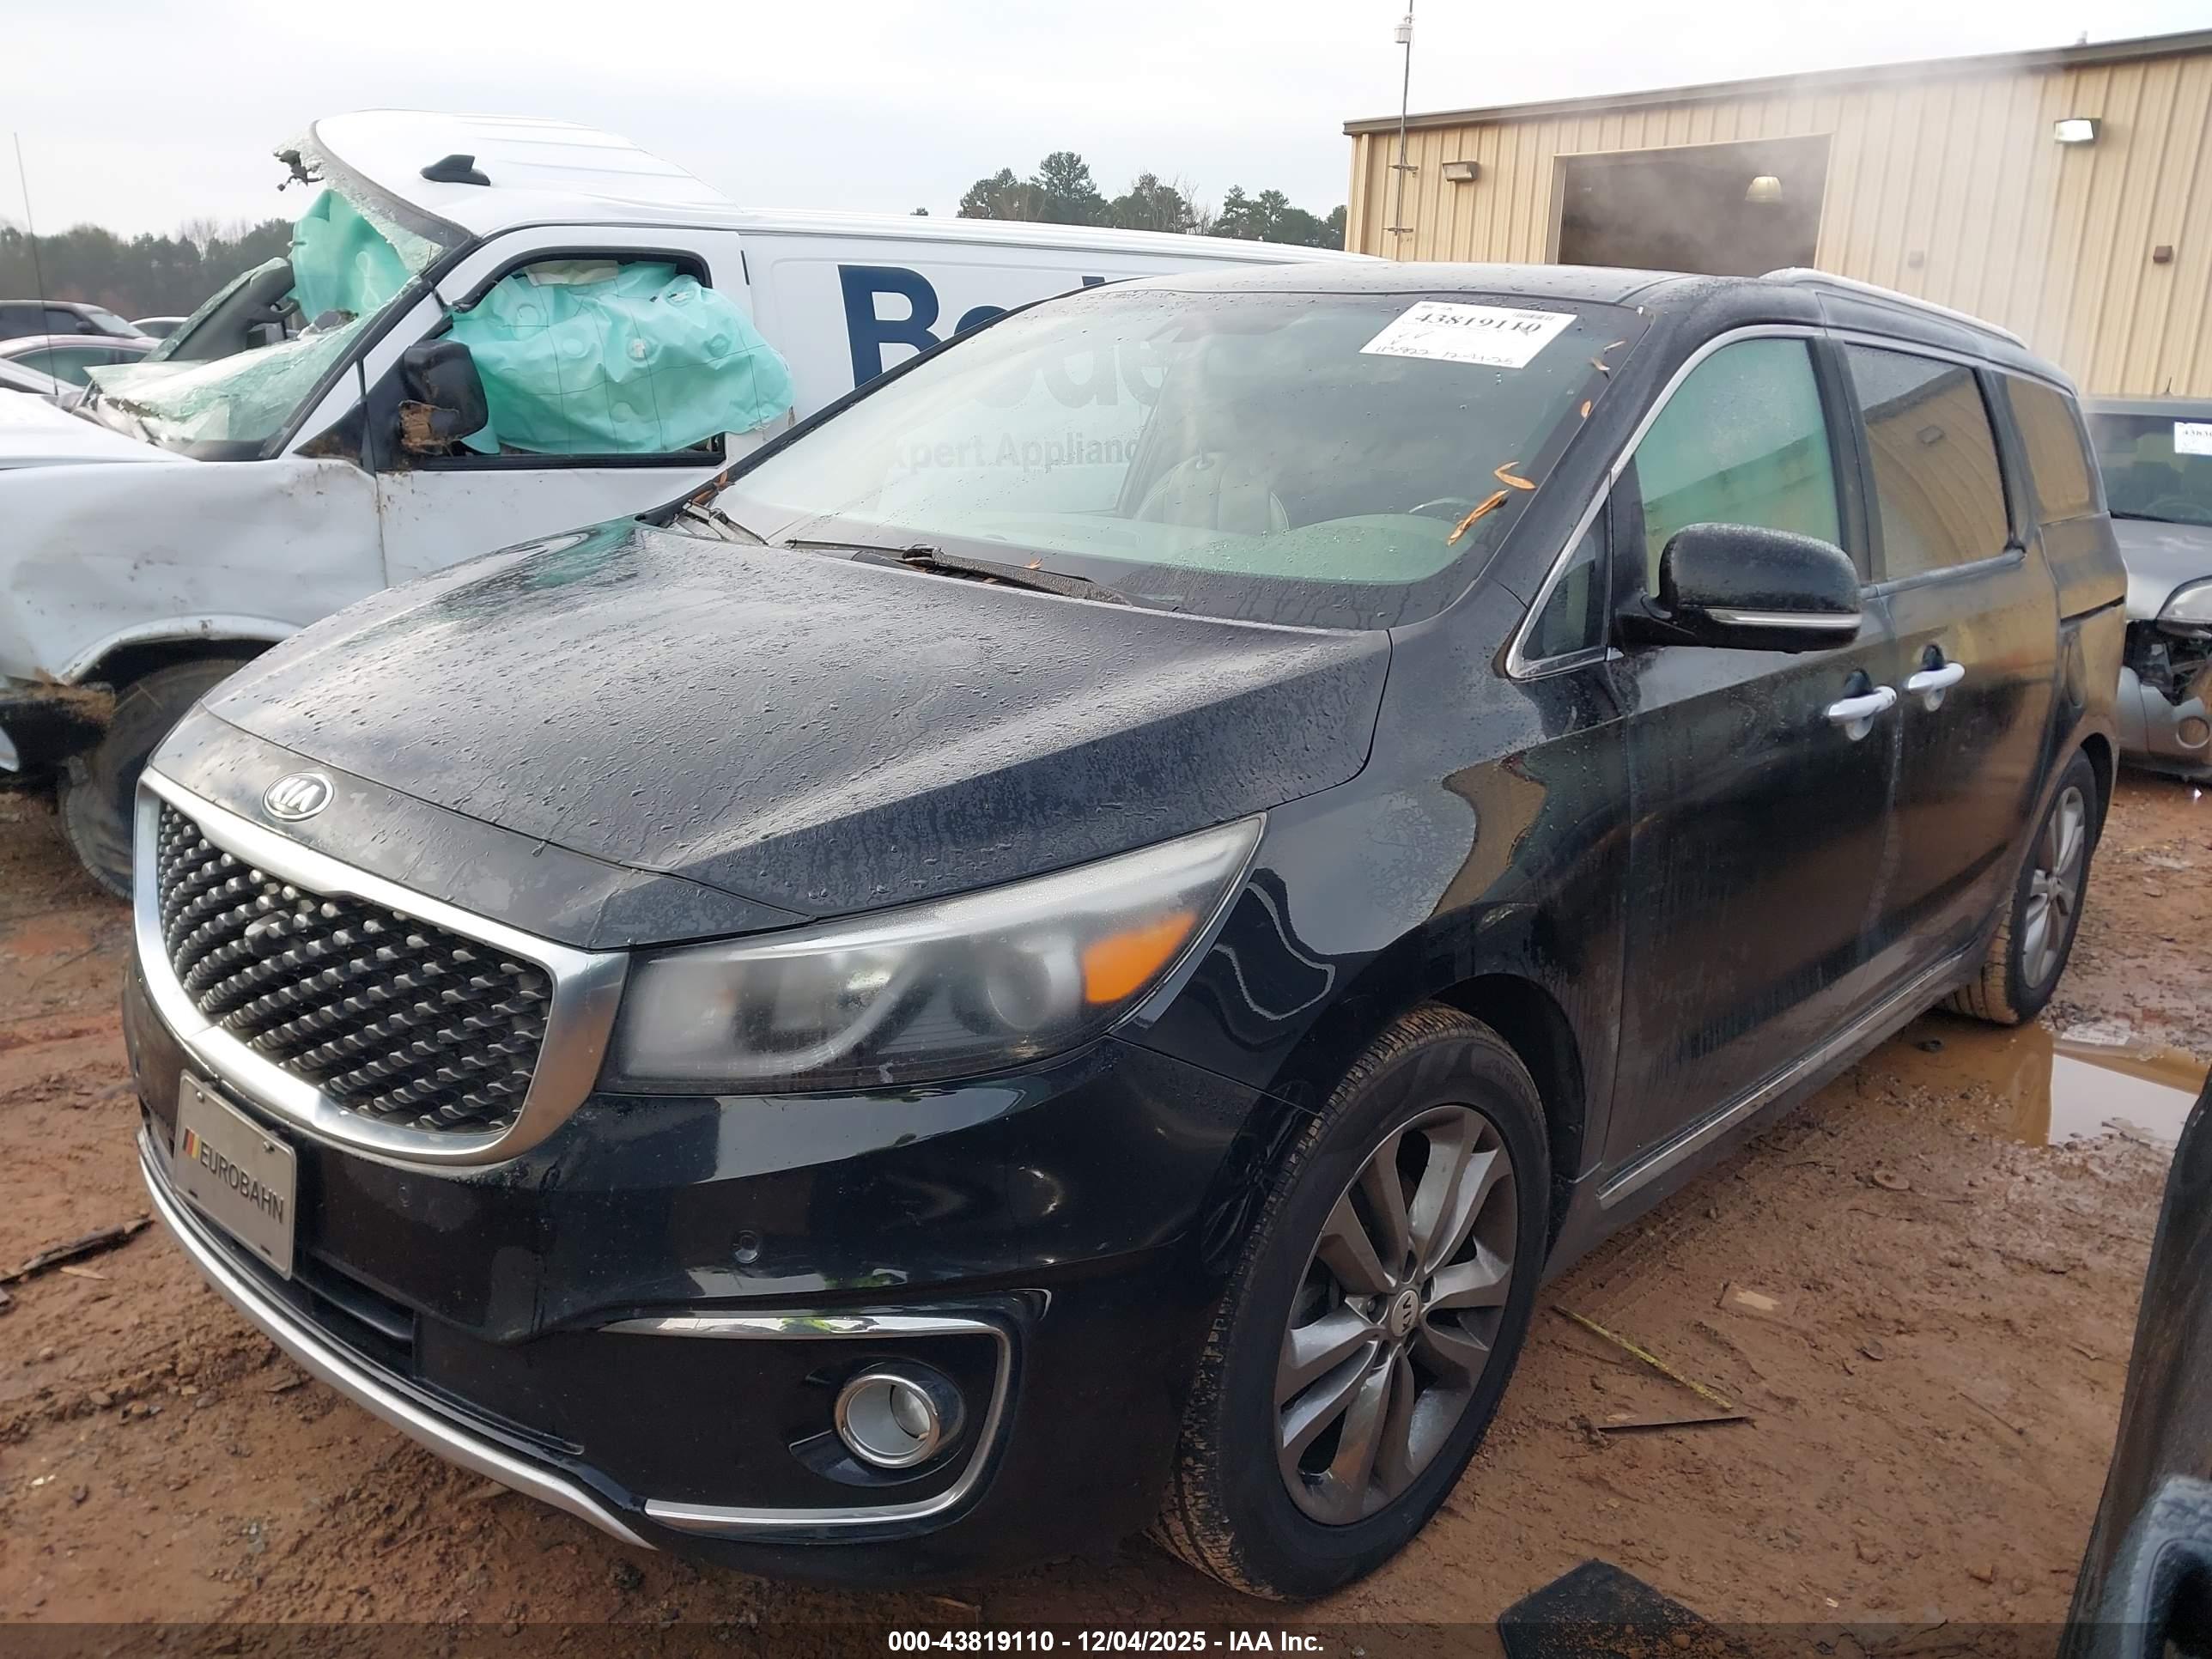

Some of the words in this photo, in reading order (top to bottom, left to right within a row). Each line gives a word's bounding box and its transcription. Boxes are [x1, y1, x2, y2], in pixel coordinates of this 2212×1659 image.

[1415, 313, 1542, 334] 43819110
[269, 776, 320, 812] KIA
[199, 1139, 284, 1224] EUROBAHN
[1401, 1295, 1413, 1333] KIA
